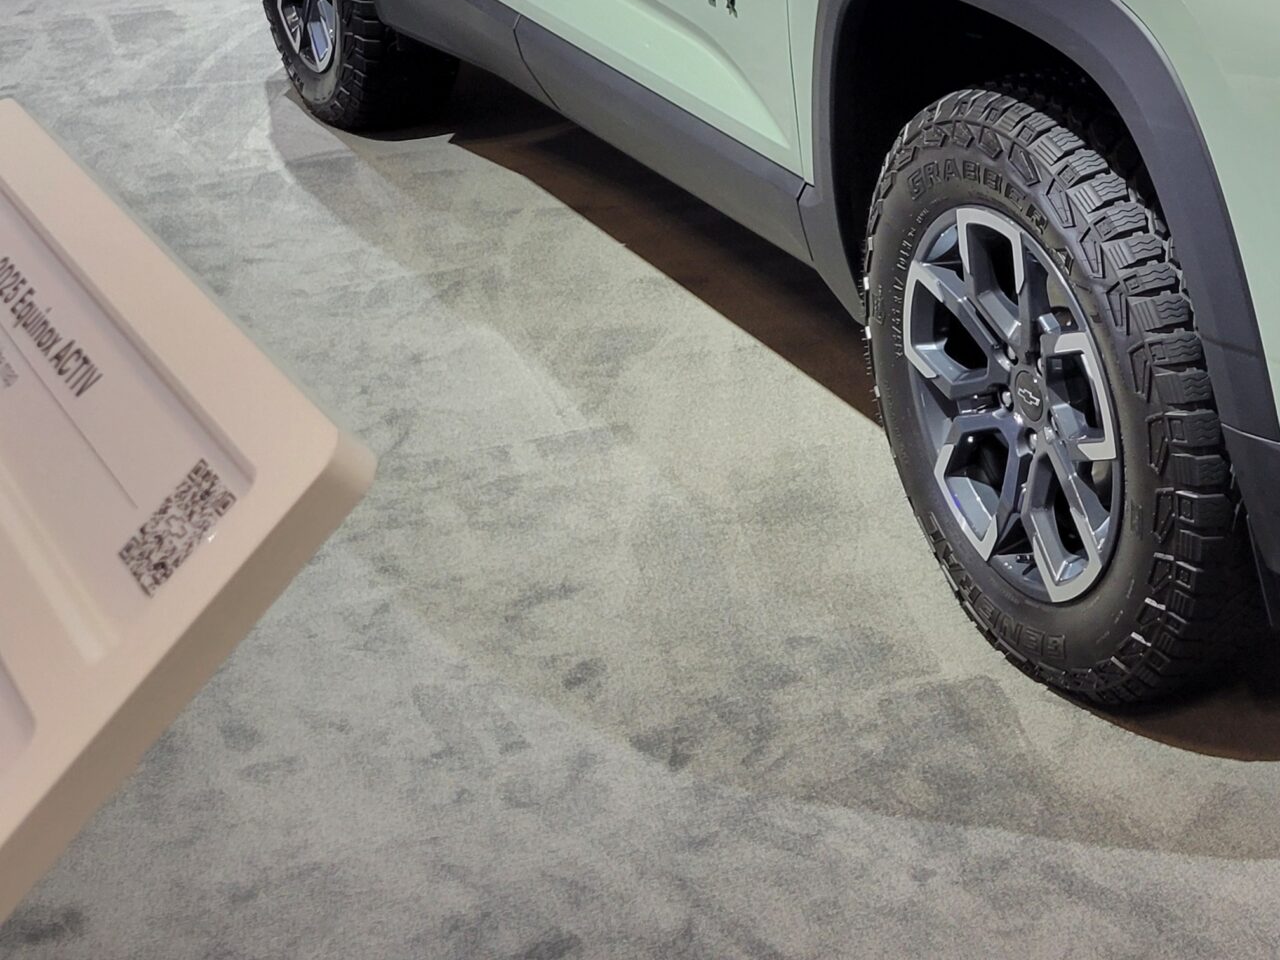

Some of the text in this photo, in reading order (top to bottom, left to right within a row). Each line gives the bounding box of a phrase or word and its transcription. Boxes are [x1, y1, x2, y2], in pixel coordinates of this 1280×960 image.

[907, 158, 1048, 235] GRABBER
[10, 287, 62, 357] Equinox
[49, 339, 104, 398] ACTIV
